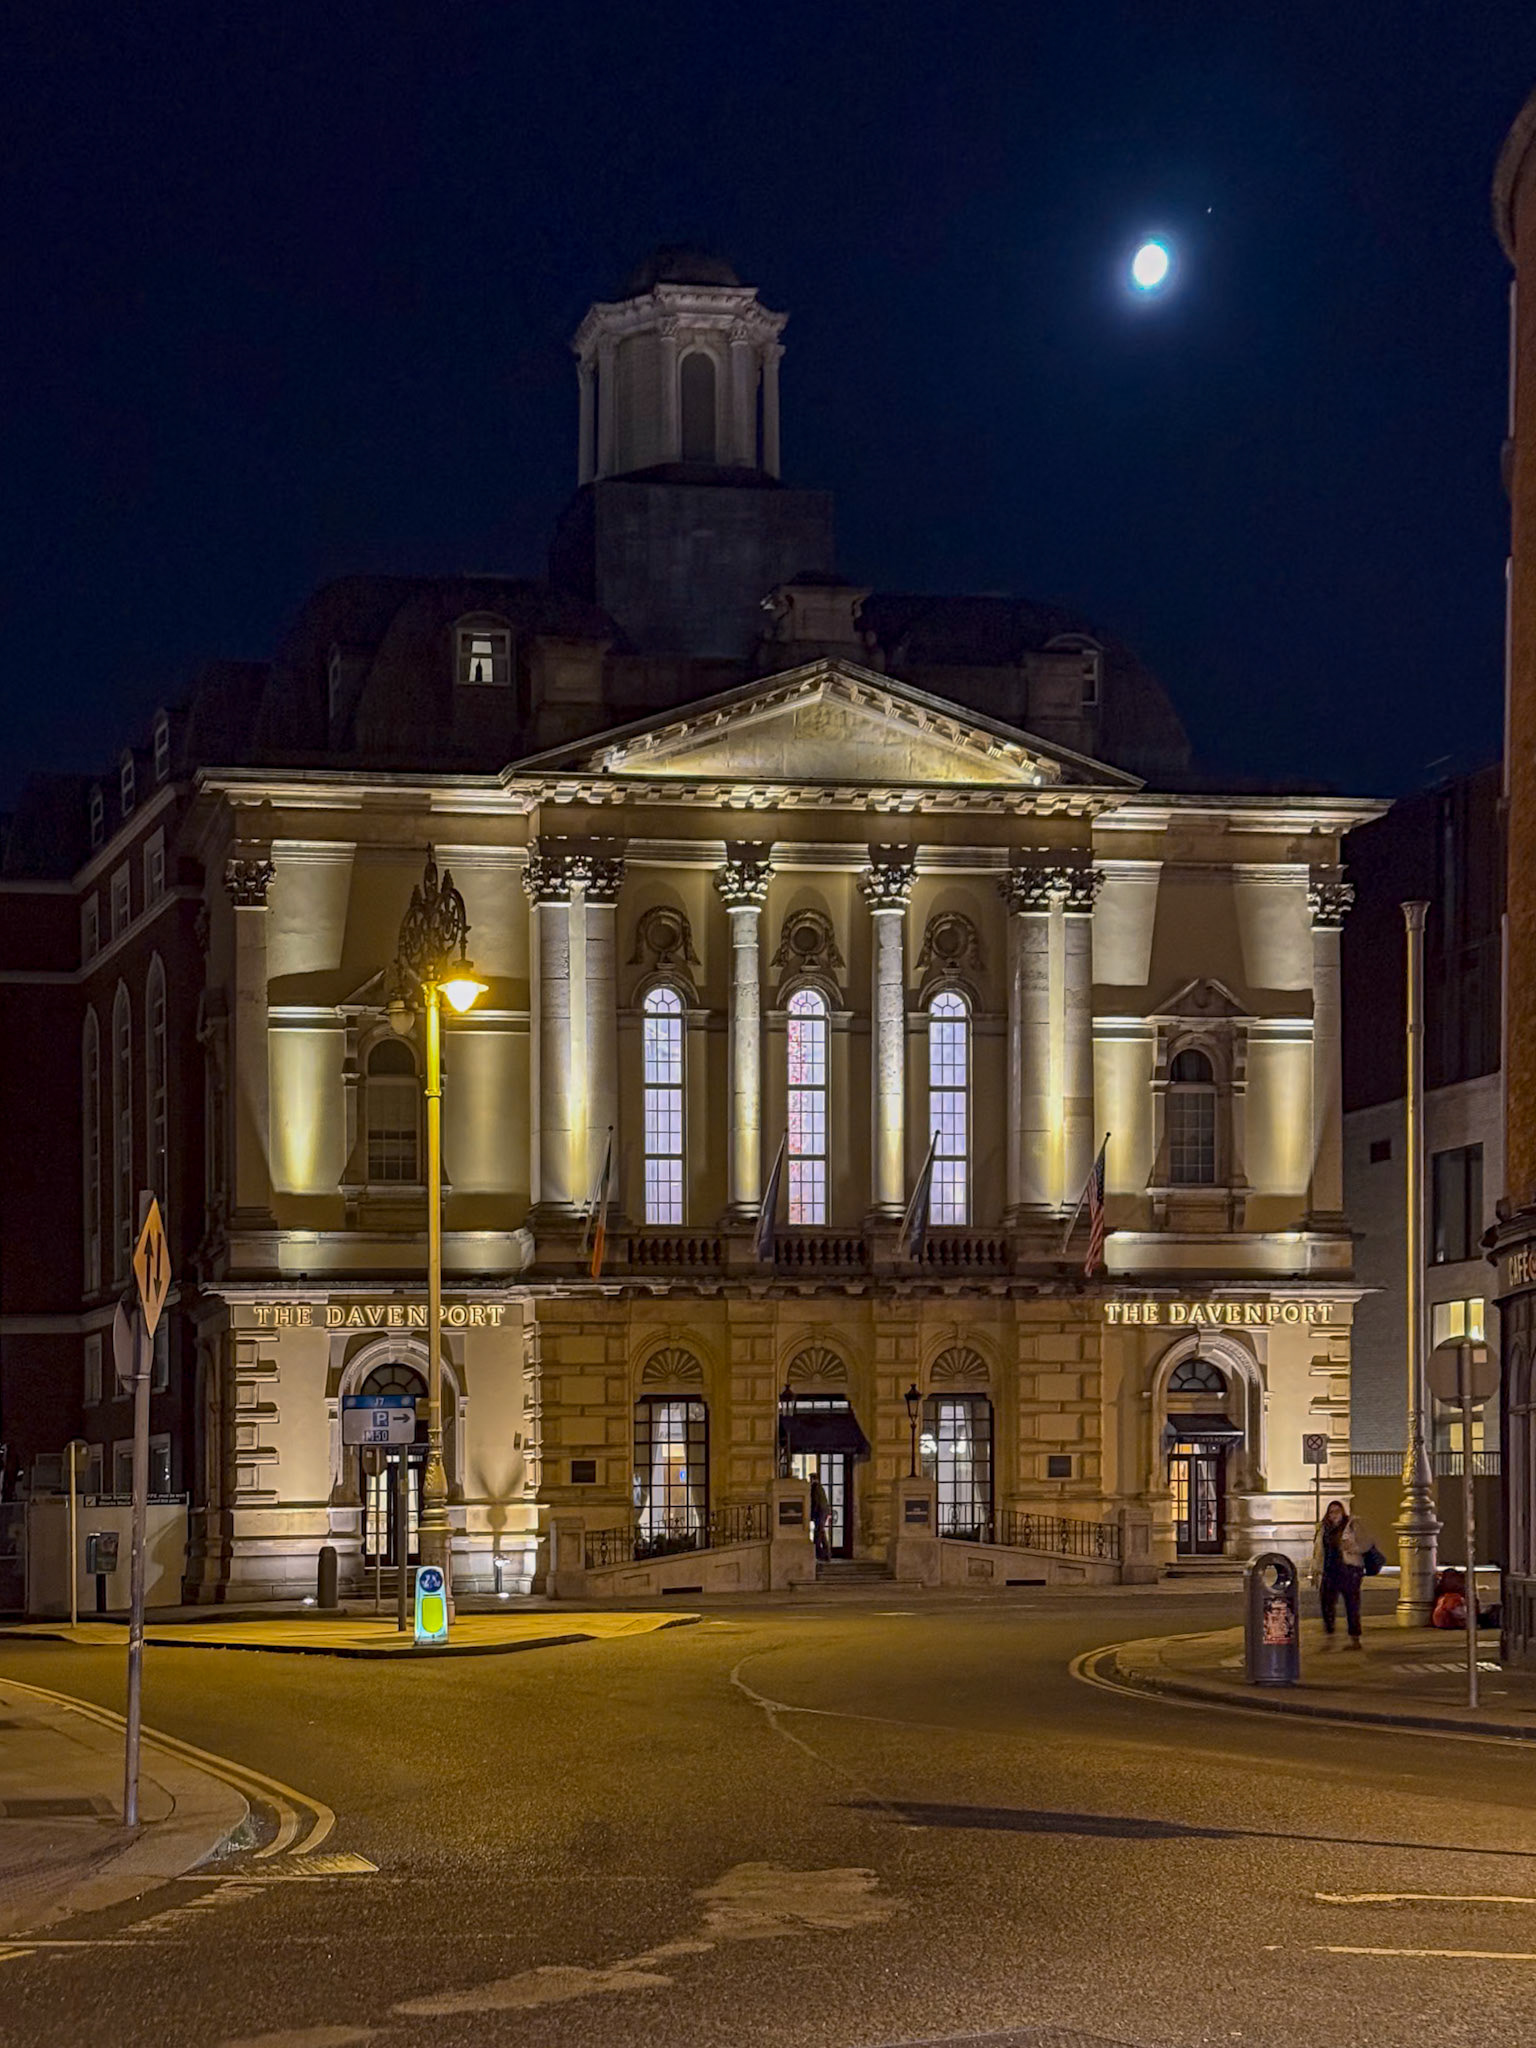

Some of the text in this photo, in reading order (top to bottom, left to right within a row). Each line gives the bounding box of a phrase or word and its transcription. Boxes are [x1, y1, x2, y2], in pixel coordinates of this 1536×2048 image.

[254, 1305, 312, 1326] THE
[1104, 1302, 1335, 1325] THE DAVENPORT
[375, 1397, 385, 1406] J7
[365, 1430, 388, 1441] M50
